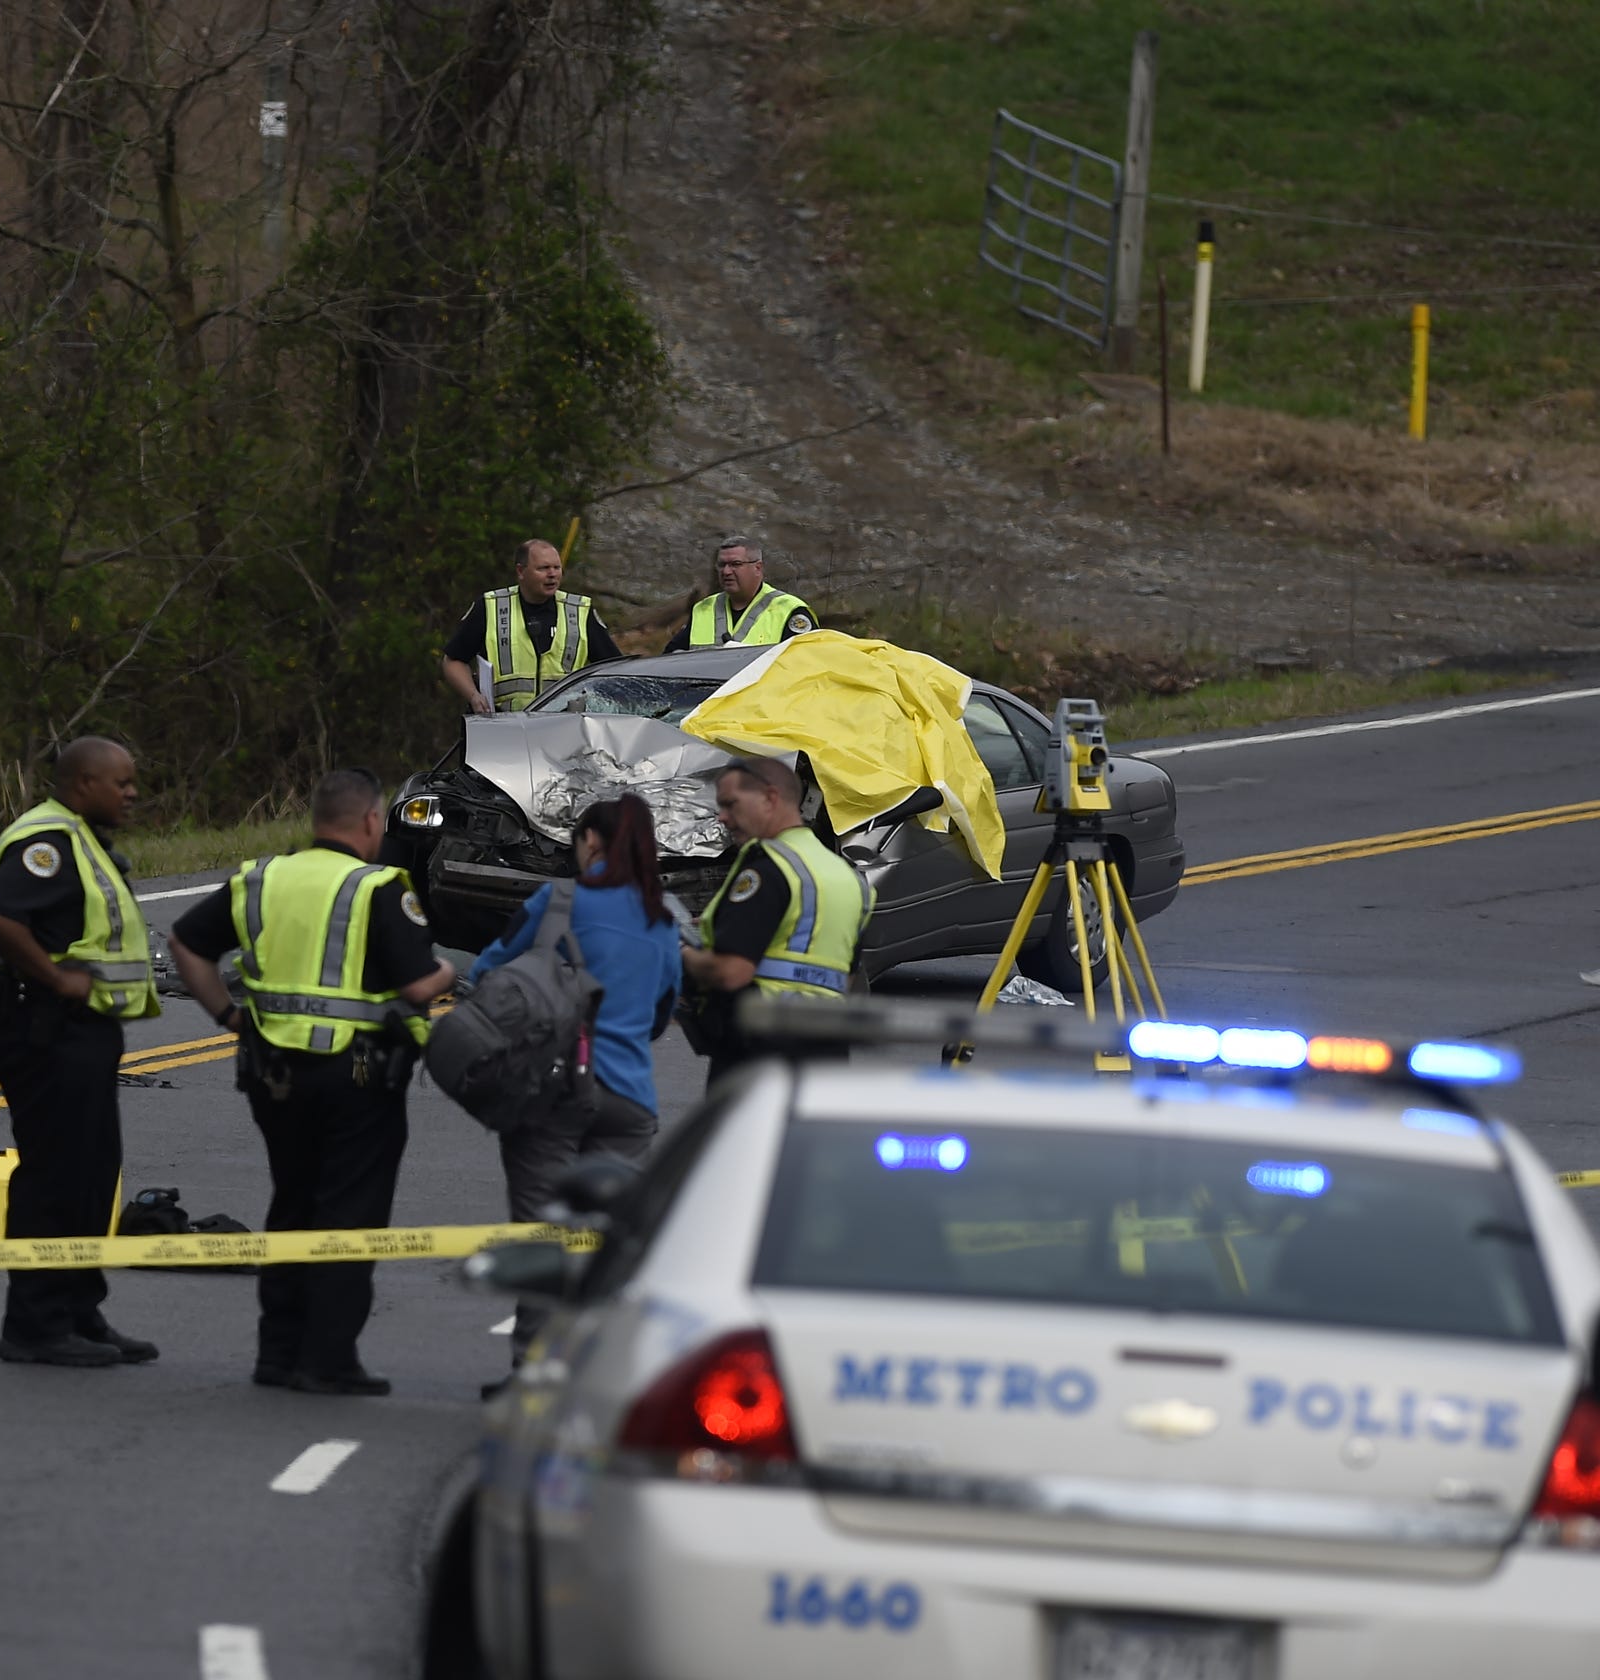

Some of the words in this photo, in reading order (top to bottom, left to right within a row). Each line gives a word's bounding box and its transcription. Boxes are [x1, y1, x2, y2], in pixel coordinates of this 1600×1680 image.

[833, 1353, 1099, 1416] METRO
[1246, 1376, 1522, 1451] POLICE
[765, 1572, 922, 1635] 1660
